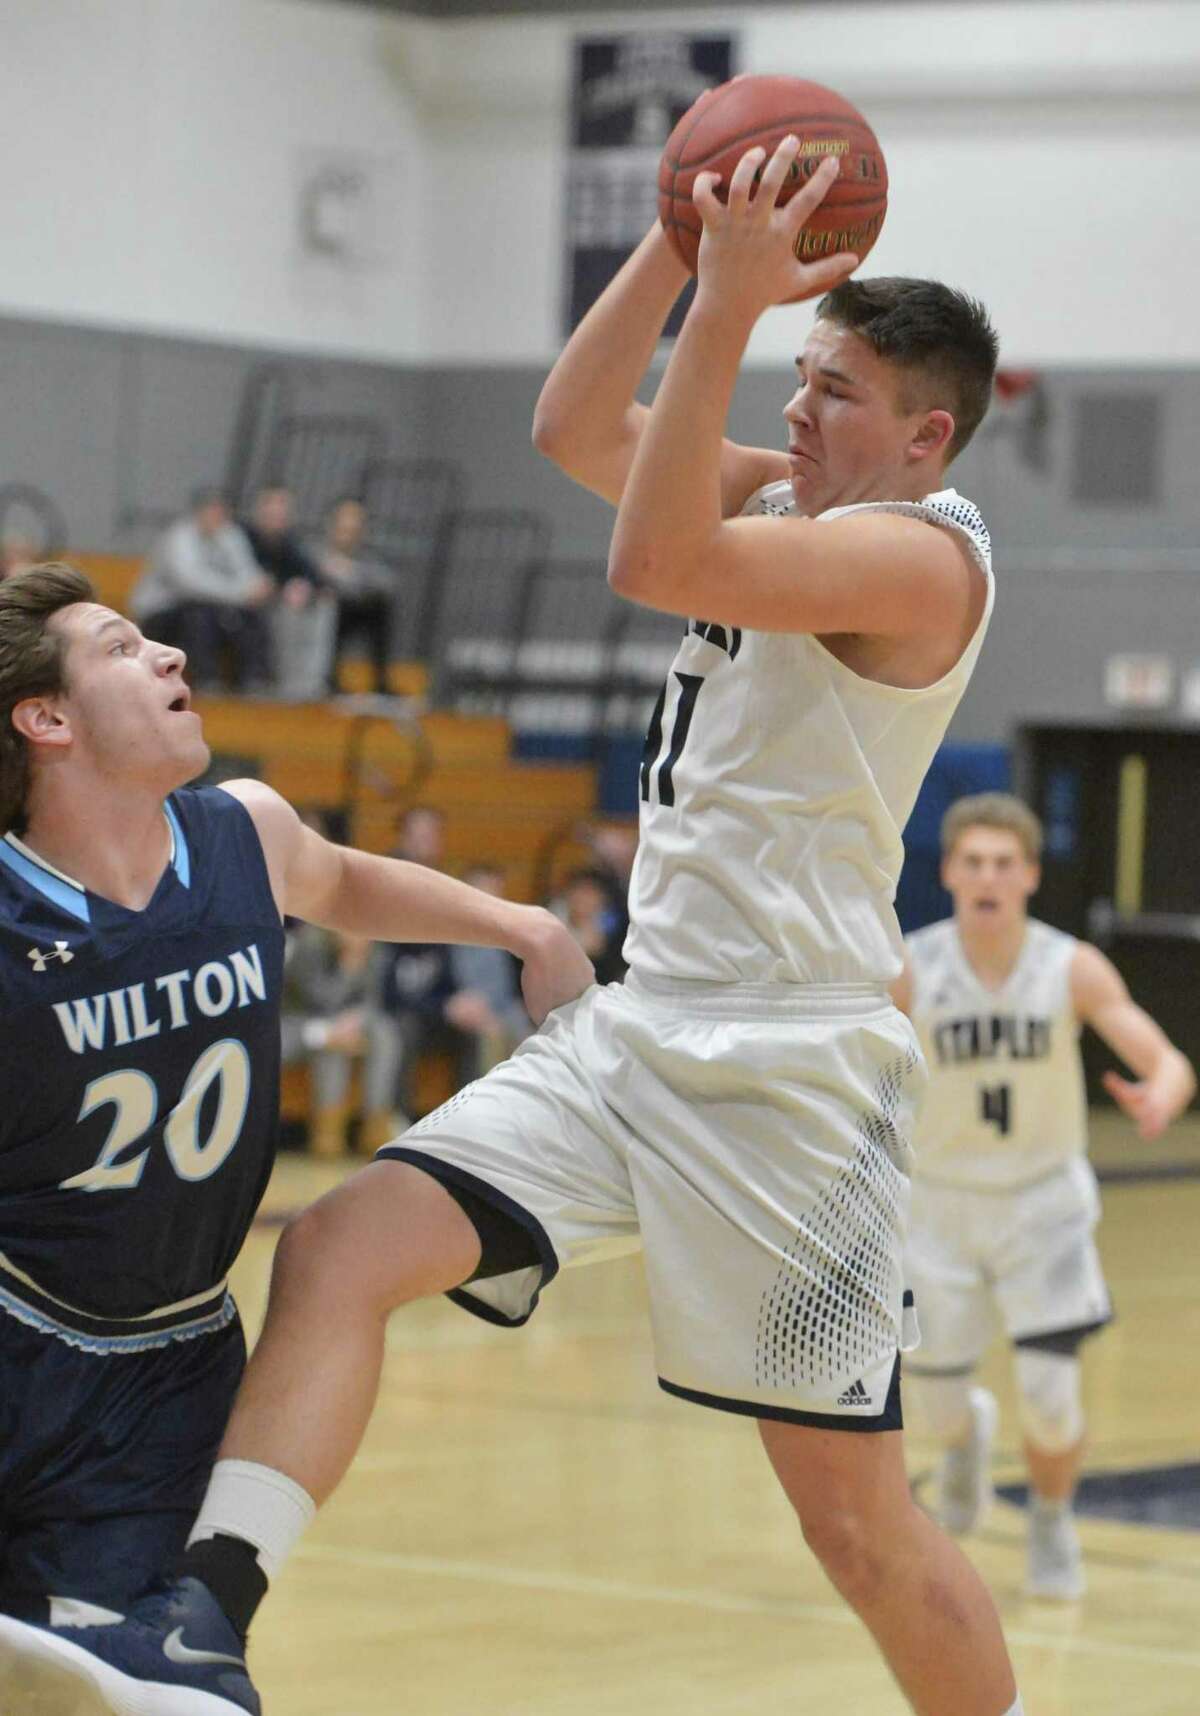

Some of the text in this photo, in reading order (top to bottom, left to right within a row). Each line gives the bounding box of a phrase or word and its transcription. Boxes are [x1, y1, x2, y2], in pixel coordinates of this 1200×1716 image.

[51, 943, 267, 1054] WILTON
[57, 1037, 251, 1192] 20
[982, 1081, 1010, 1136] 4
